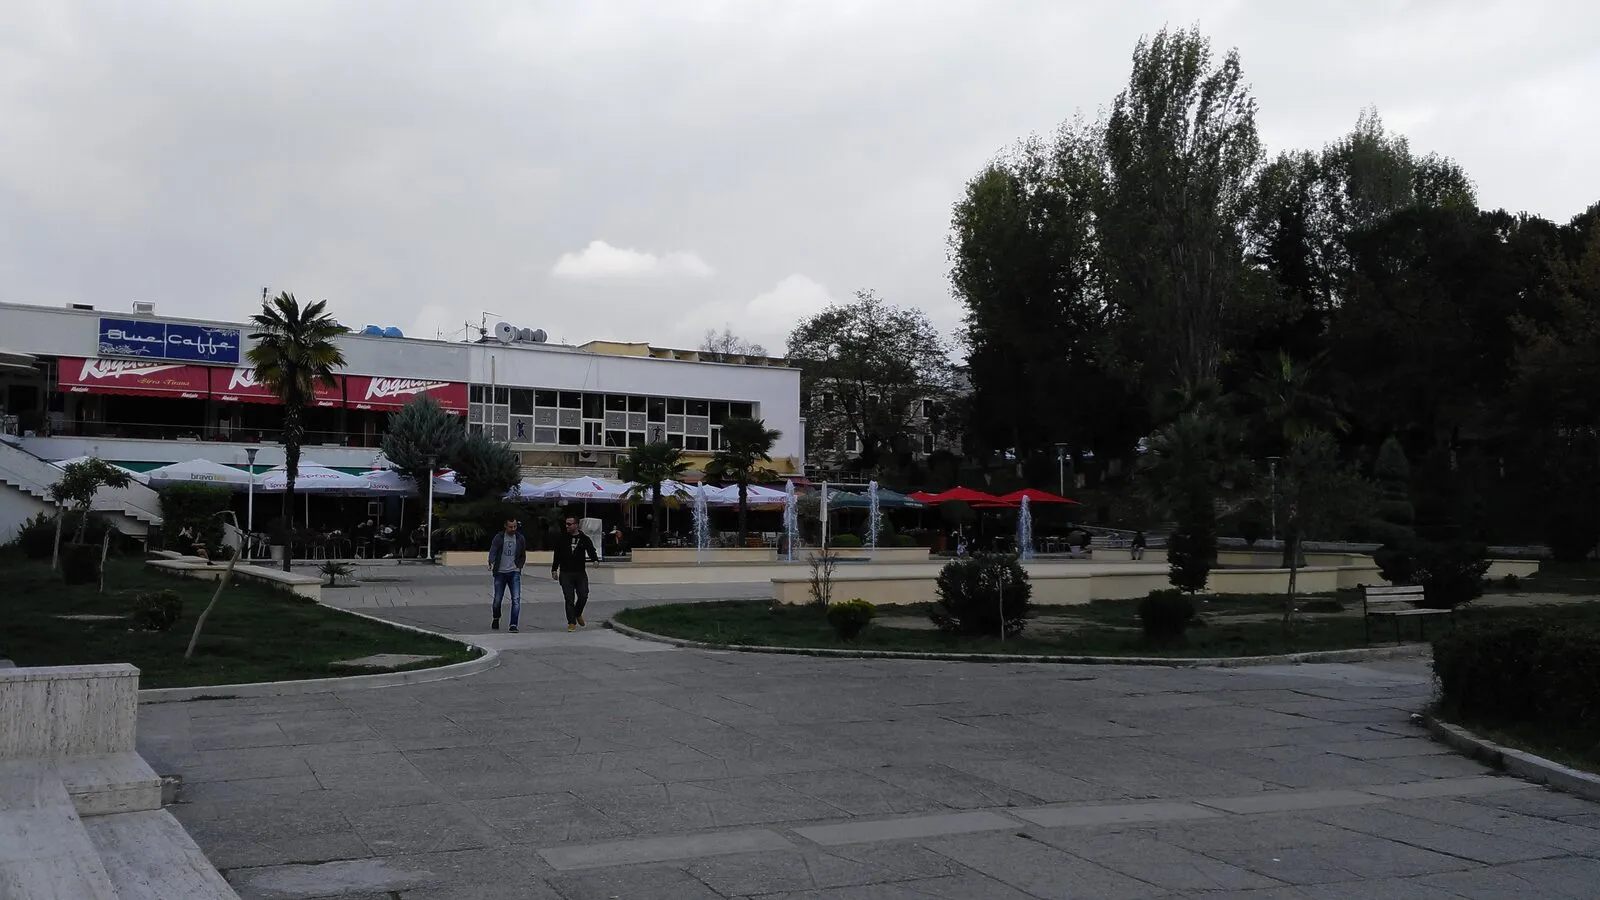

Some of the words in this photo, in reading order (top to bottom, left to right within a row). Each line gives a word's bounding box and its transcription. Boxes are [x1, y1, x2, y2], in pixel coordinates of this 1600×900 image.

[108, 329, 162, 343] Blue
[168, 334, 236, 355] Caffe
[190, 472, 213, 481] bravo
